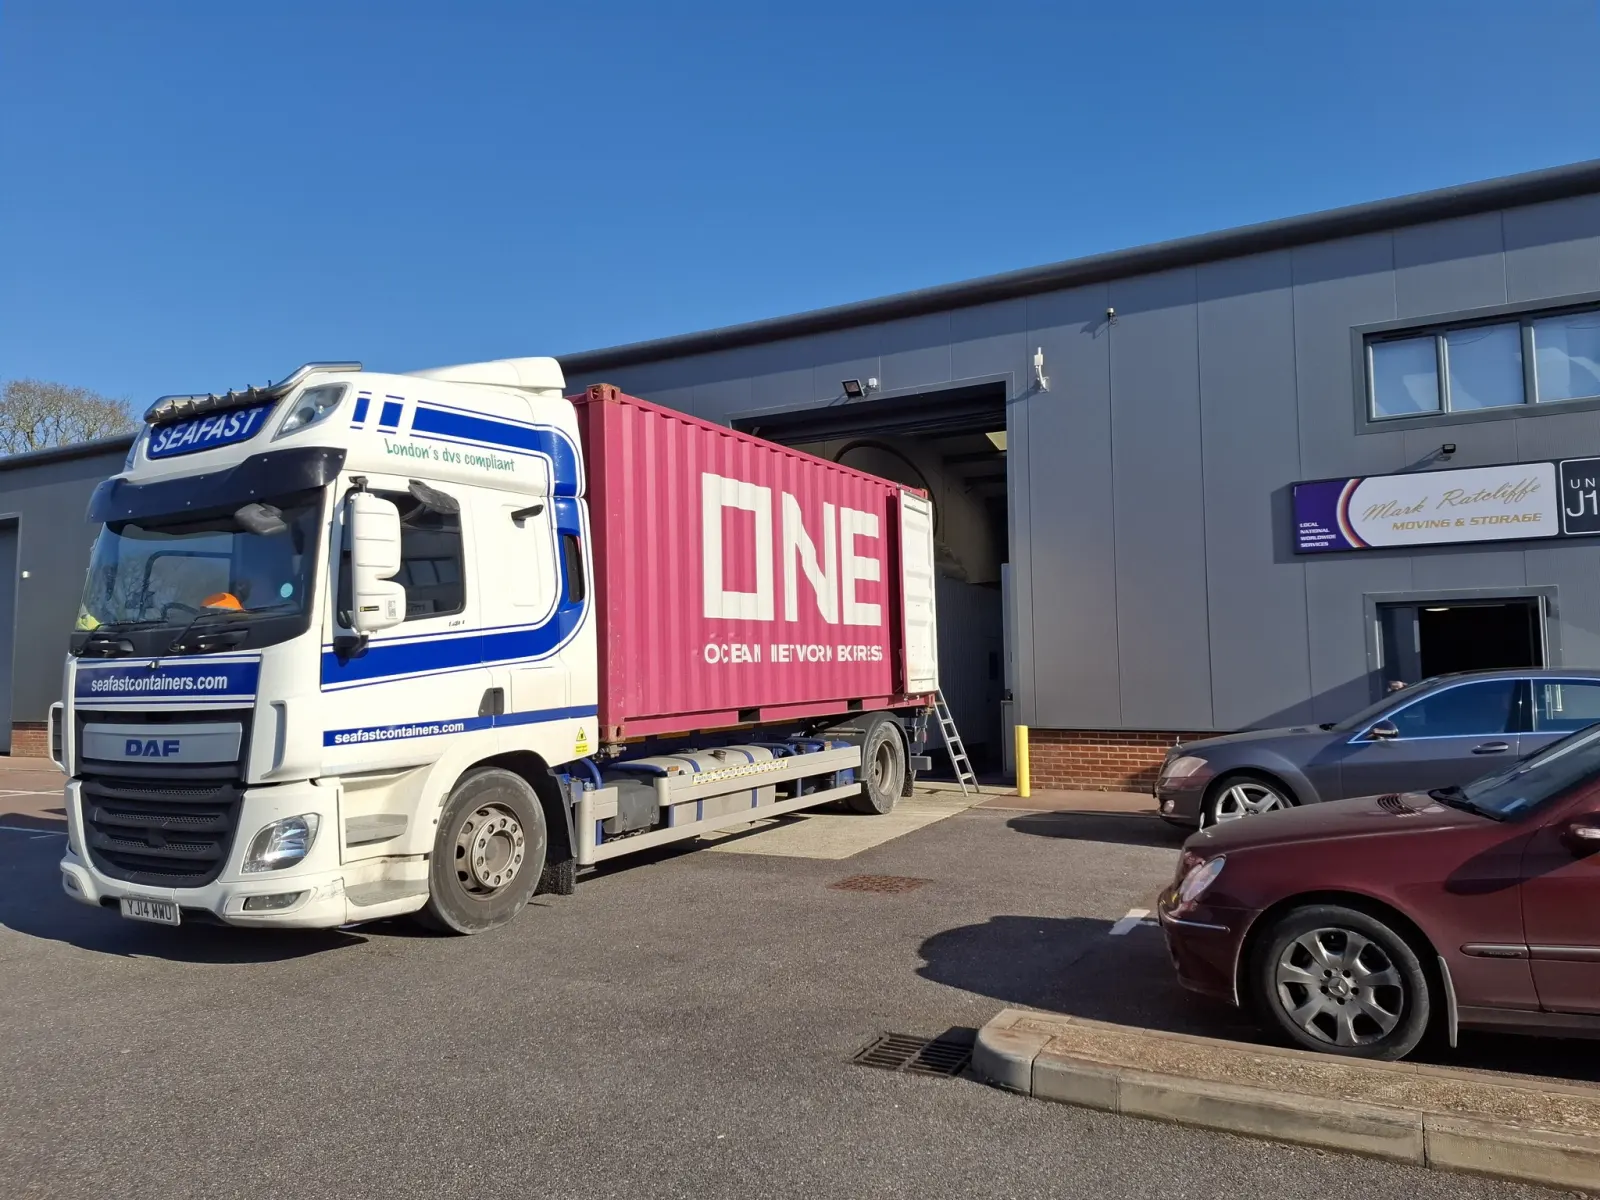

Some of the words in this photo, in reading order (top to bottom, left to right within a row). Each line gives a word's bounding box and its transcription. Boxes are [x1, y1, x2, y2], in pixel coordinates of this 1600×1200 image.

[153, 407, 263, 453] SEAFAST
[443, 448, 461, 464] dvs
[464, 454, 515, 472] compliant
[1362, 496, 1428, 522] Mark
[1436, 477, 1541, 510] Ratcliffe
[1392, 518, 1451, 531] MOVING
[1454, 518, 1466, 528] &
[1470, 512, 1542, 526] STORAGE
[702, 472, 882, 626] ONE
[704, 643, 761, 664] OCEAN
[91, 674, 227, 692] seafastcontainers.com
[335, 722, 464, 744] seafastcontainers.com
[125, 739, 180, 757] DAF
[127, 900, 150, 917] YJ14
